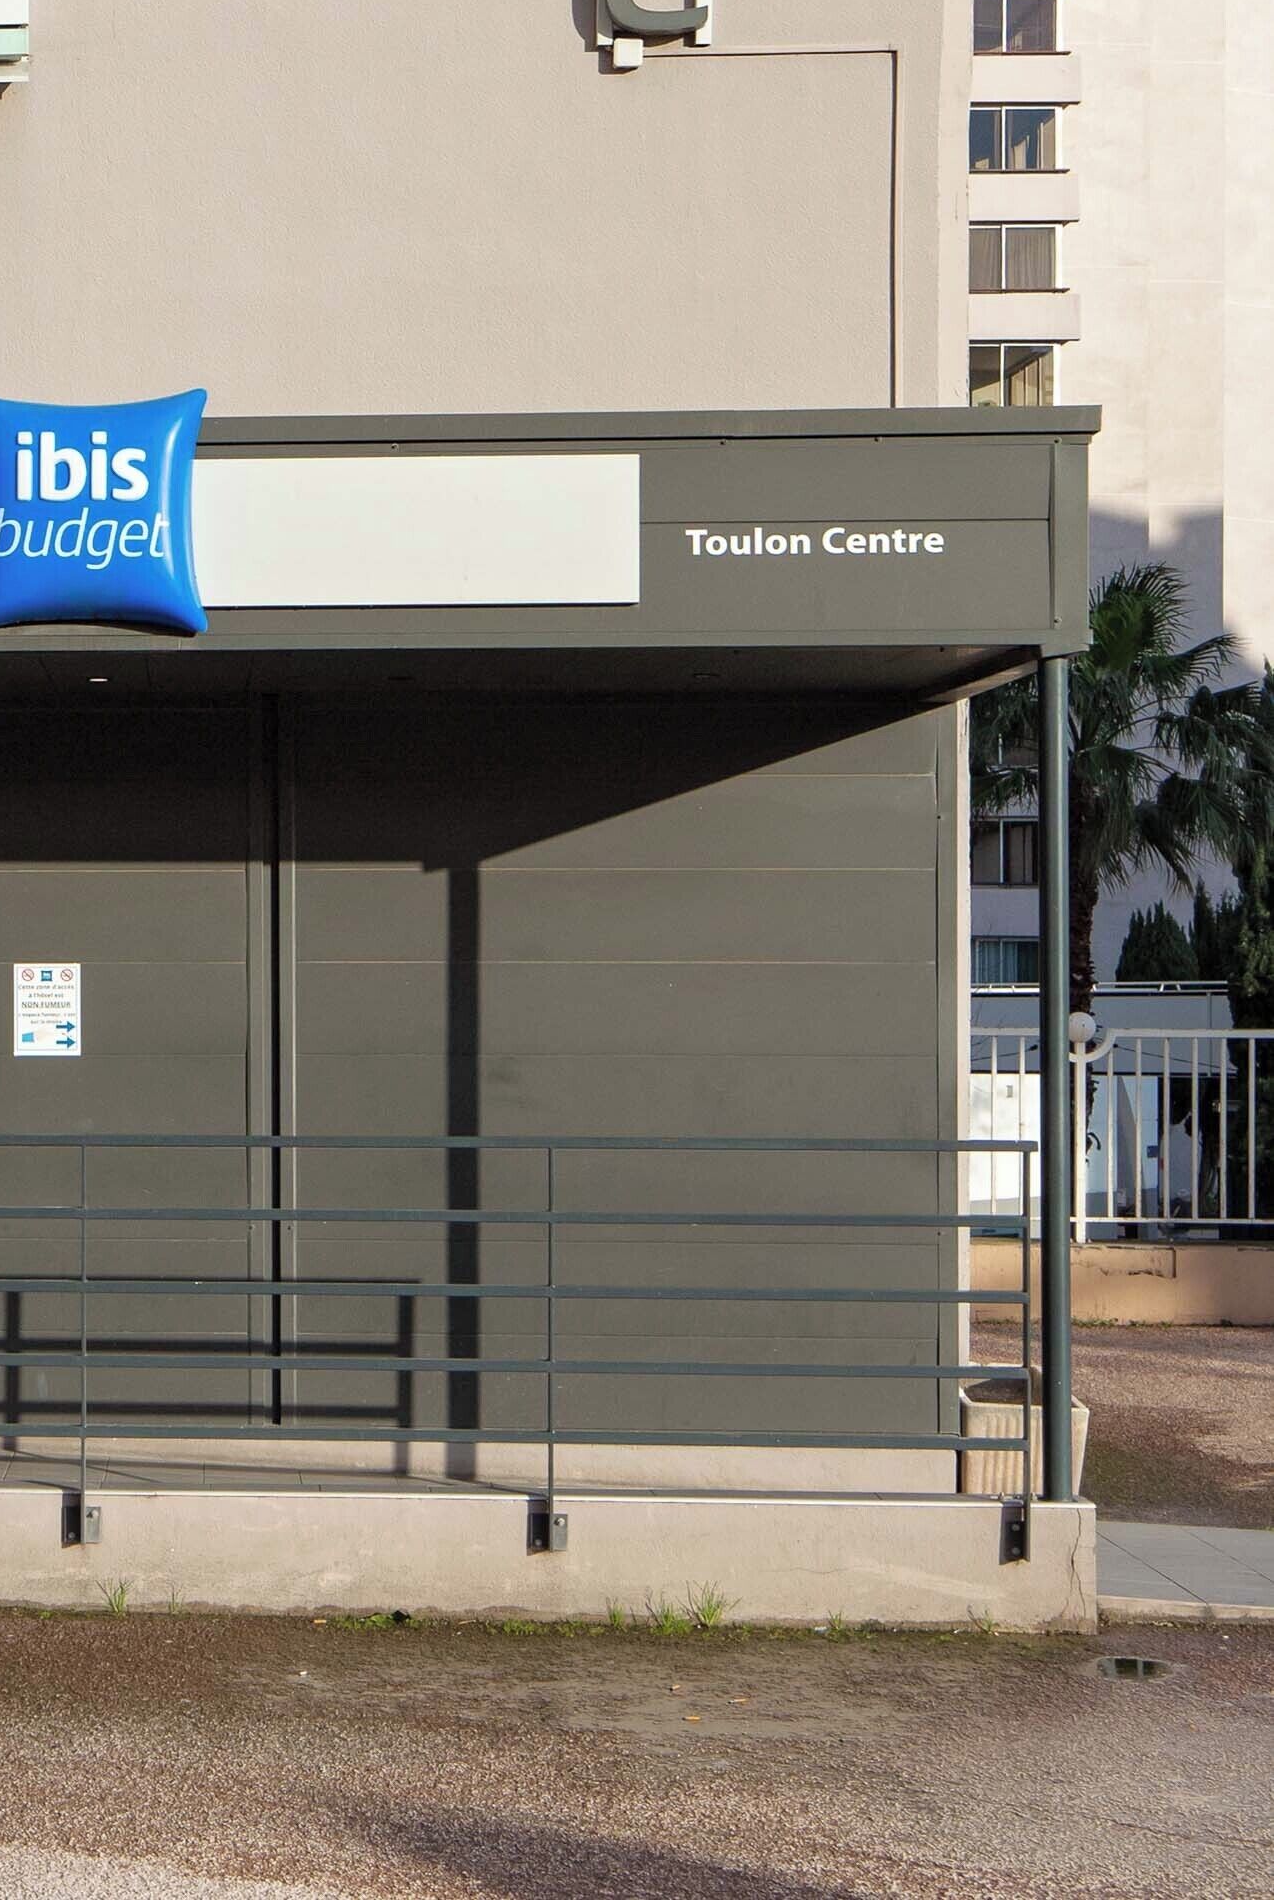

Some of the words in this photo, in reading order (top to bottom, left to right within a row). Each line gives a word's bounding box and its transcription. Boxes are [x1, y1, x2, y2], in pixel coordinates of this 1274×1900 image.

[16, 430, 150, 502] ibis
[685, 527, 812, 556] Toulon
[821, 527, 945, 554] Centre
